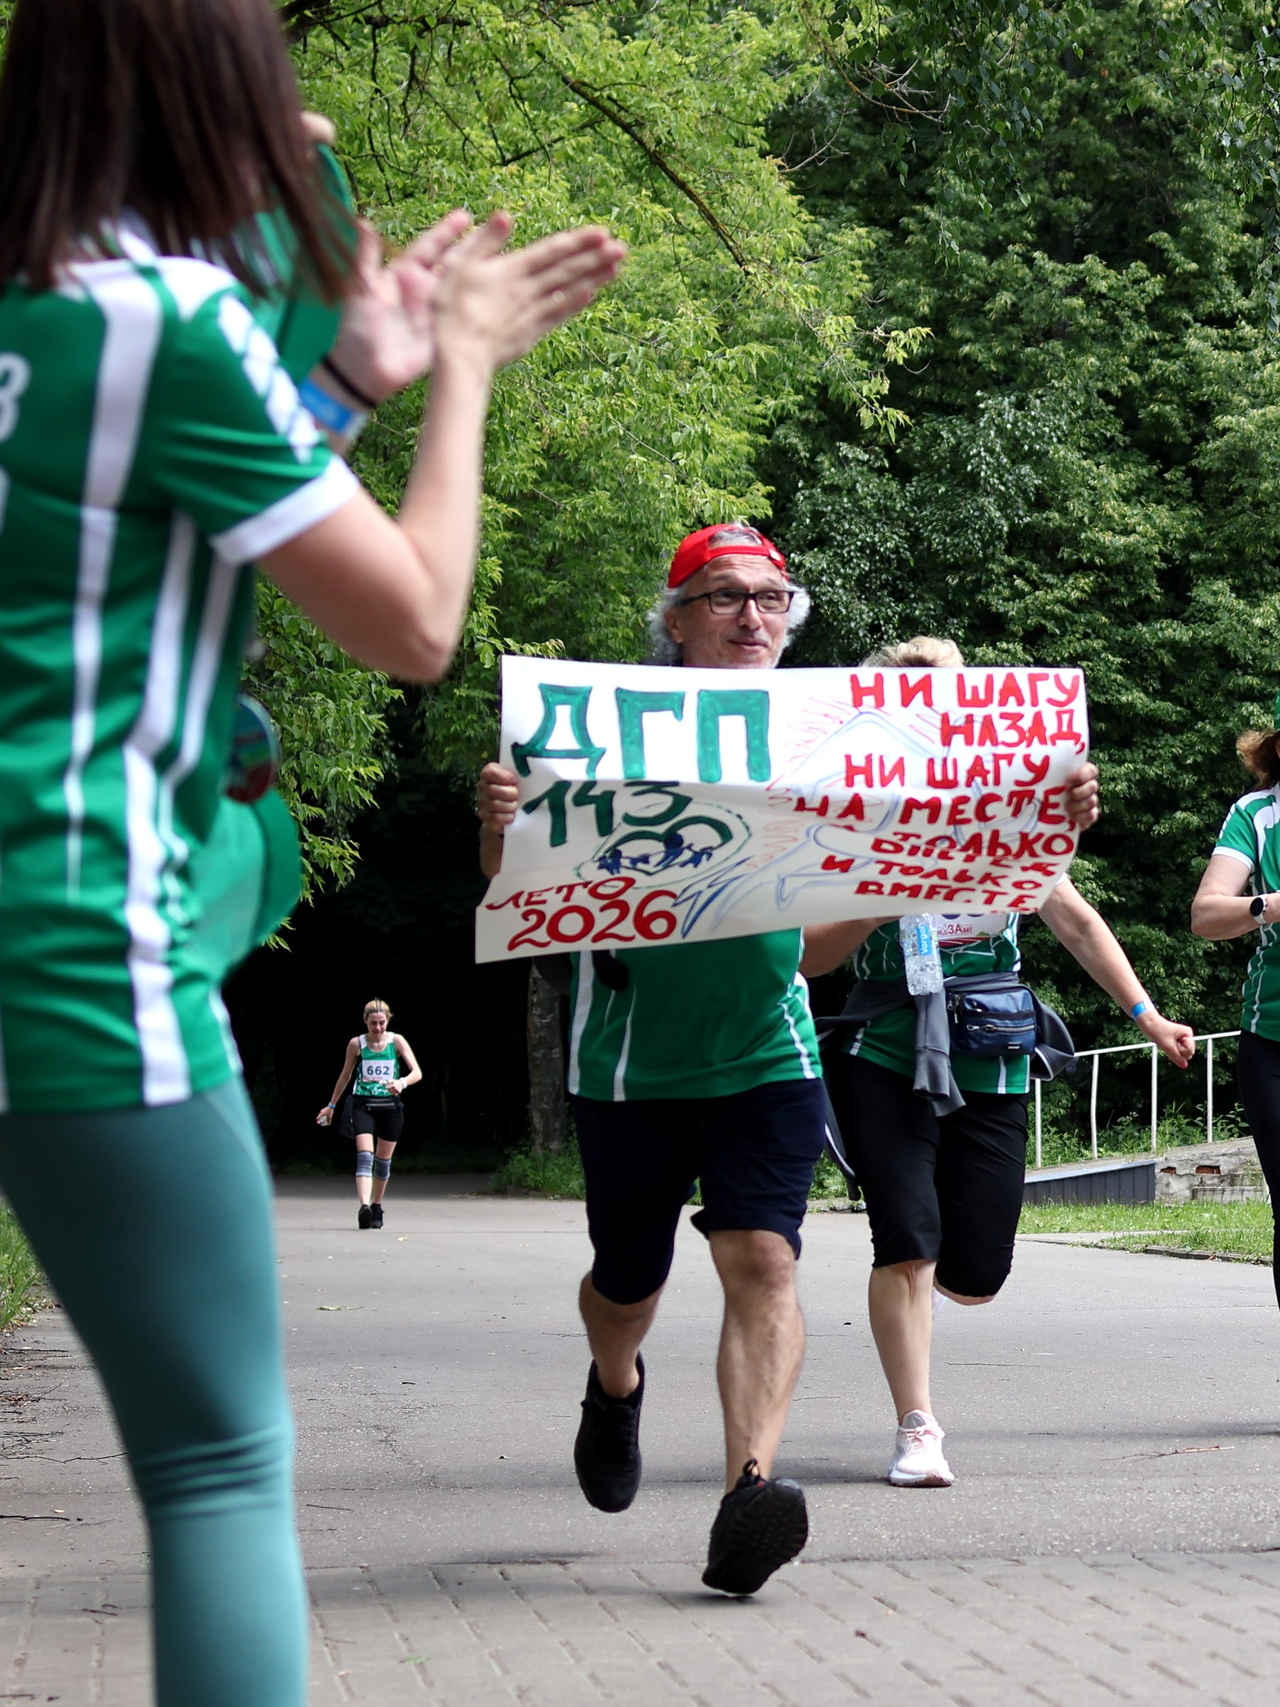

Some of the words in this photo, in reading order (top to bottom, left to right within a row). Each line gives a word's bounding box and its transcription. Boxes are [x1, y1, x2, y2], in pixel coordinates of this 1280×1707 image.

[850, 672, 933, 708] НИ
[956, 672, 1080, 708] ШАГУ
[510, 682, 772, 783] ДГП
[940, 709, 1086, 755] НАЗАД,
[844, 753, 905, 788] НИ
[926, 753, 1051, 789] ШАГУ
[521, 780, 693, 848] 143
[820, 855, 855, 873] И
[874, 859, 1043, 891] ТОЛЬКО
[485, 876, 637, 911] ЛЕТО
[506, 889, 678, 952] 2026
[366, 1065, 390, 1076] 662
